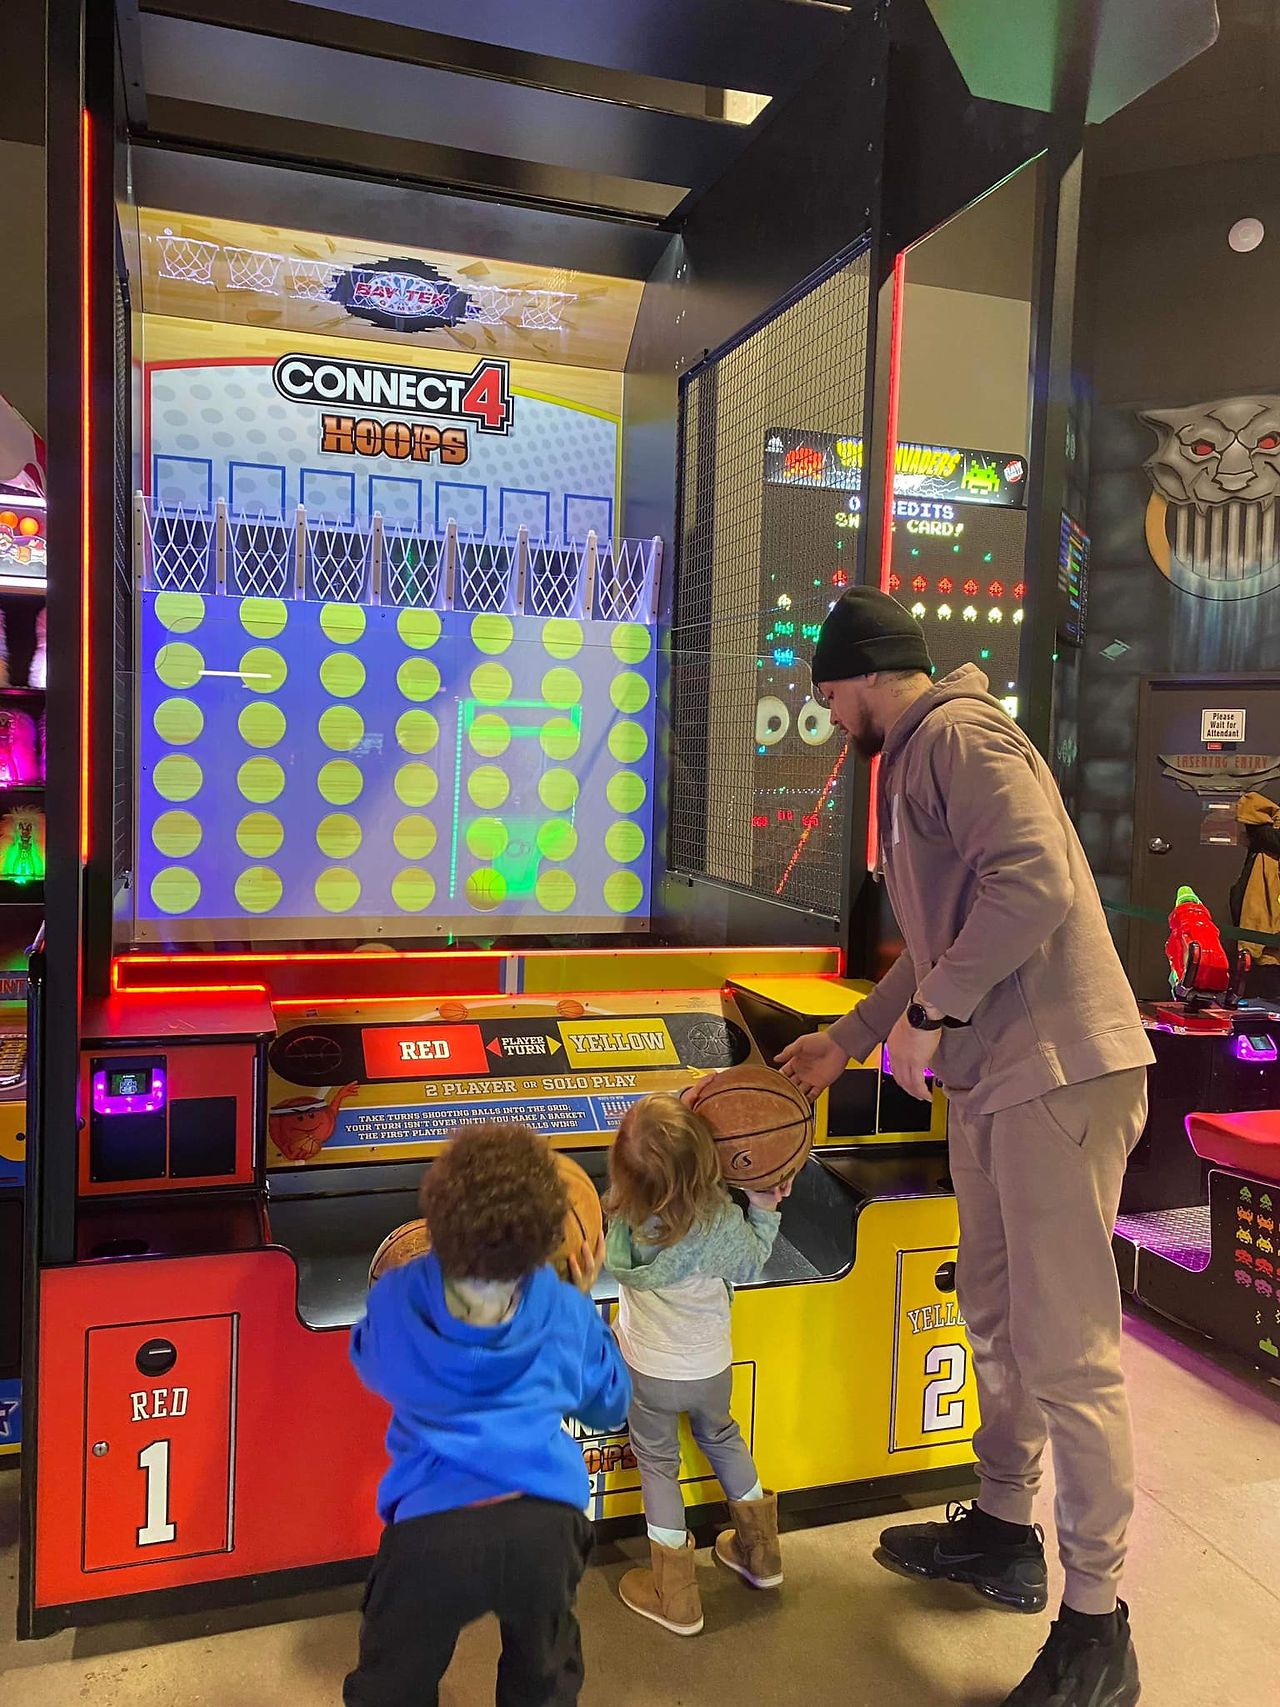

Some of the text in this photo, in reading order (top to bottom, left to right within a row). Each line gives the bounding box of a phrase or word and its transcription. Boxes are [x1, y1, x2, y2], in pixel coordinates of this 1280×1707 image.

[355, 283, 450, 306] BAY TEK
[281, 361, 507, 426] CONNECT 4
[321, 413, 469, 465] HOOPS
[894, 442, 962, 478] NVADERS
[893, 500, 954, 519] EDITS
[906, 519, 965, 537] CARD!
[1206, 729, 1240, 737] Attendant
[1210, 721, 1237, 729] Wait for
[1235, 756, 1268, 769] ENTRY
[399, 1040, 451, 1060] RED
[501, 1036, 545, 1046] PLAYER
[504, 1044, 546, 1056] TURN
[568, 1031, 665, 1053] YELLOW
[425, 1074, 637, 1097] 2 PLAYER OR SOLO PLAY
[345, 1123, 373, 1132] YOUR
[374, 1122, 401, 1130] TURN
[404, 1121, 430, 1129] ISN'T
[432, 1119, 457, 1127] OVER
[491, 1115, 508, 1123] YOU
[548, 1111, 586, 1120] BASKET!
[358, 1114, 385, 1122] TAKE
[387, 1112, 420, 1121] TURNS
[422, 1109, 469, 1119] SHOOTING
[472, 1107, 501, 1116] BALLS
[503, 1106, 525, 1114] INTO
[358, 1132, 379, 1140] THE
[381, 1130, 409, 1138] FIRST
[411, 1128, 448, 1137] PLAYER
[551, 1120, 578, 1128] WINS!
[907, 1302, 967, 1334] YELL
[921, 1343, 967, 1434] 2
[130, 1387, 189, 1422] RED
[582, 1442, 638, 1475] OPS
[136, 1438, 177, 1548] 1
